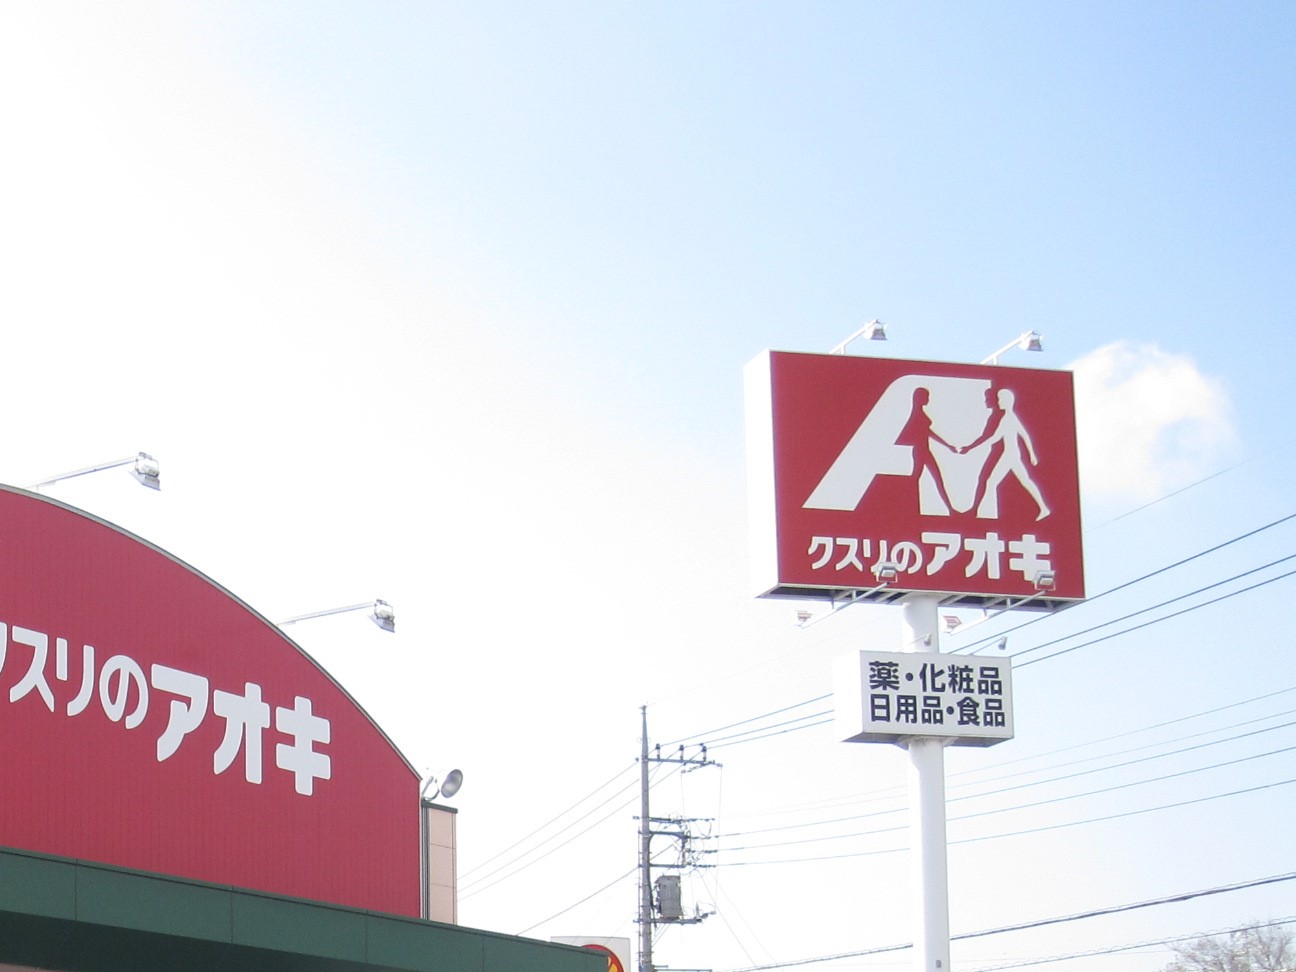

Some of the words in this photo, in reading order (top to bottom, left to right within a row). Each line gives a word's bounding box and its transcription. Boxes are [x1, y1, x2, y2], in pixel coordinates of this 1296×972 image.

[808, 532, 1051, 582] クスリのアオキ
[868, 660, 1003, 696] 薬・化粧品
[870, 693, 1006, 728] 日用品・食品
